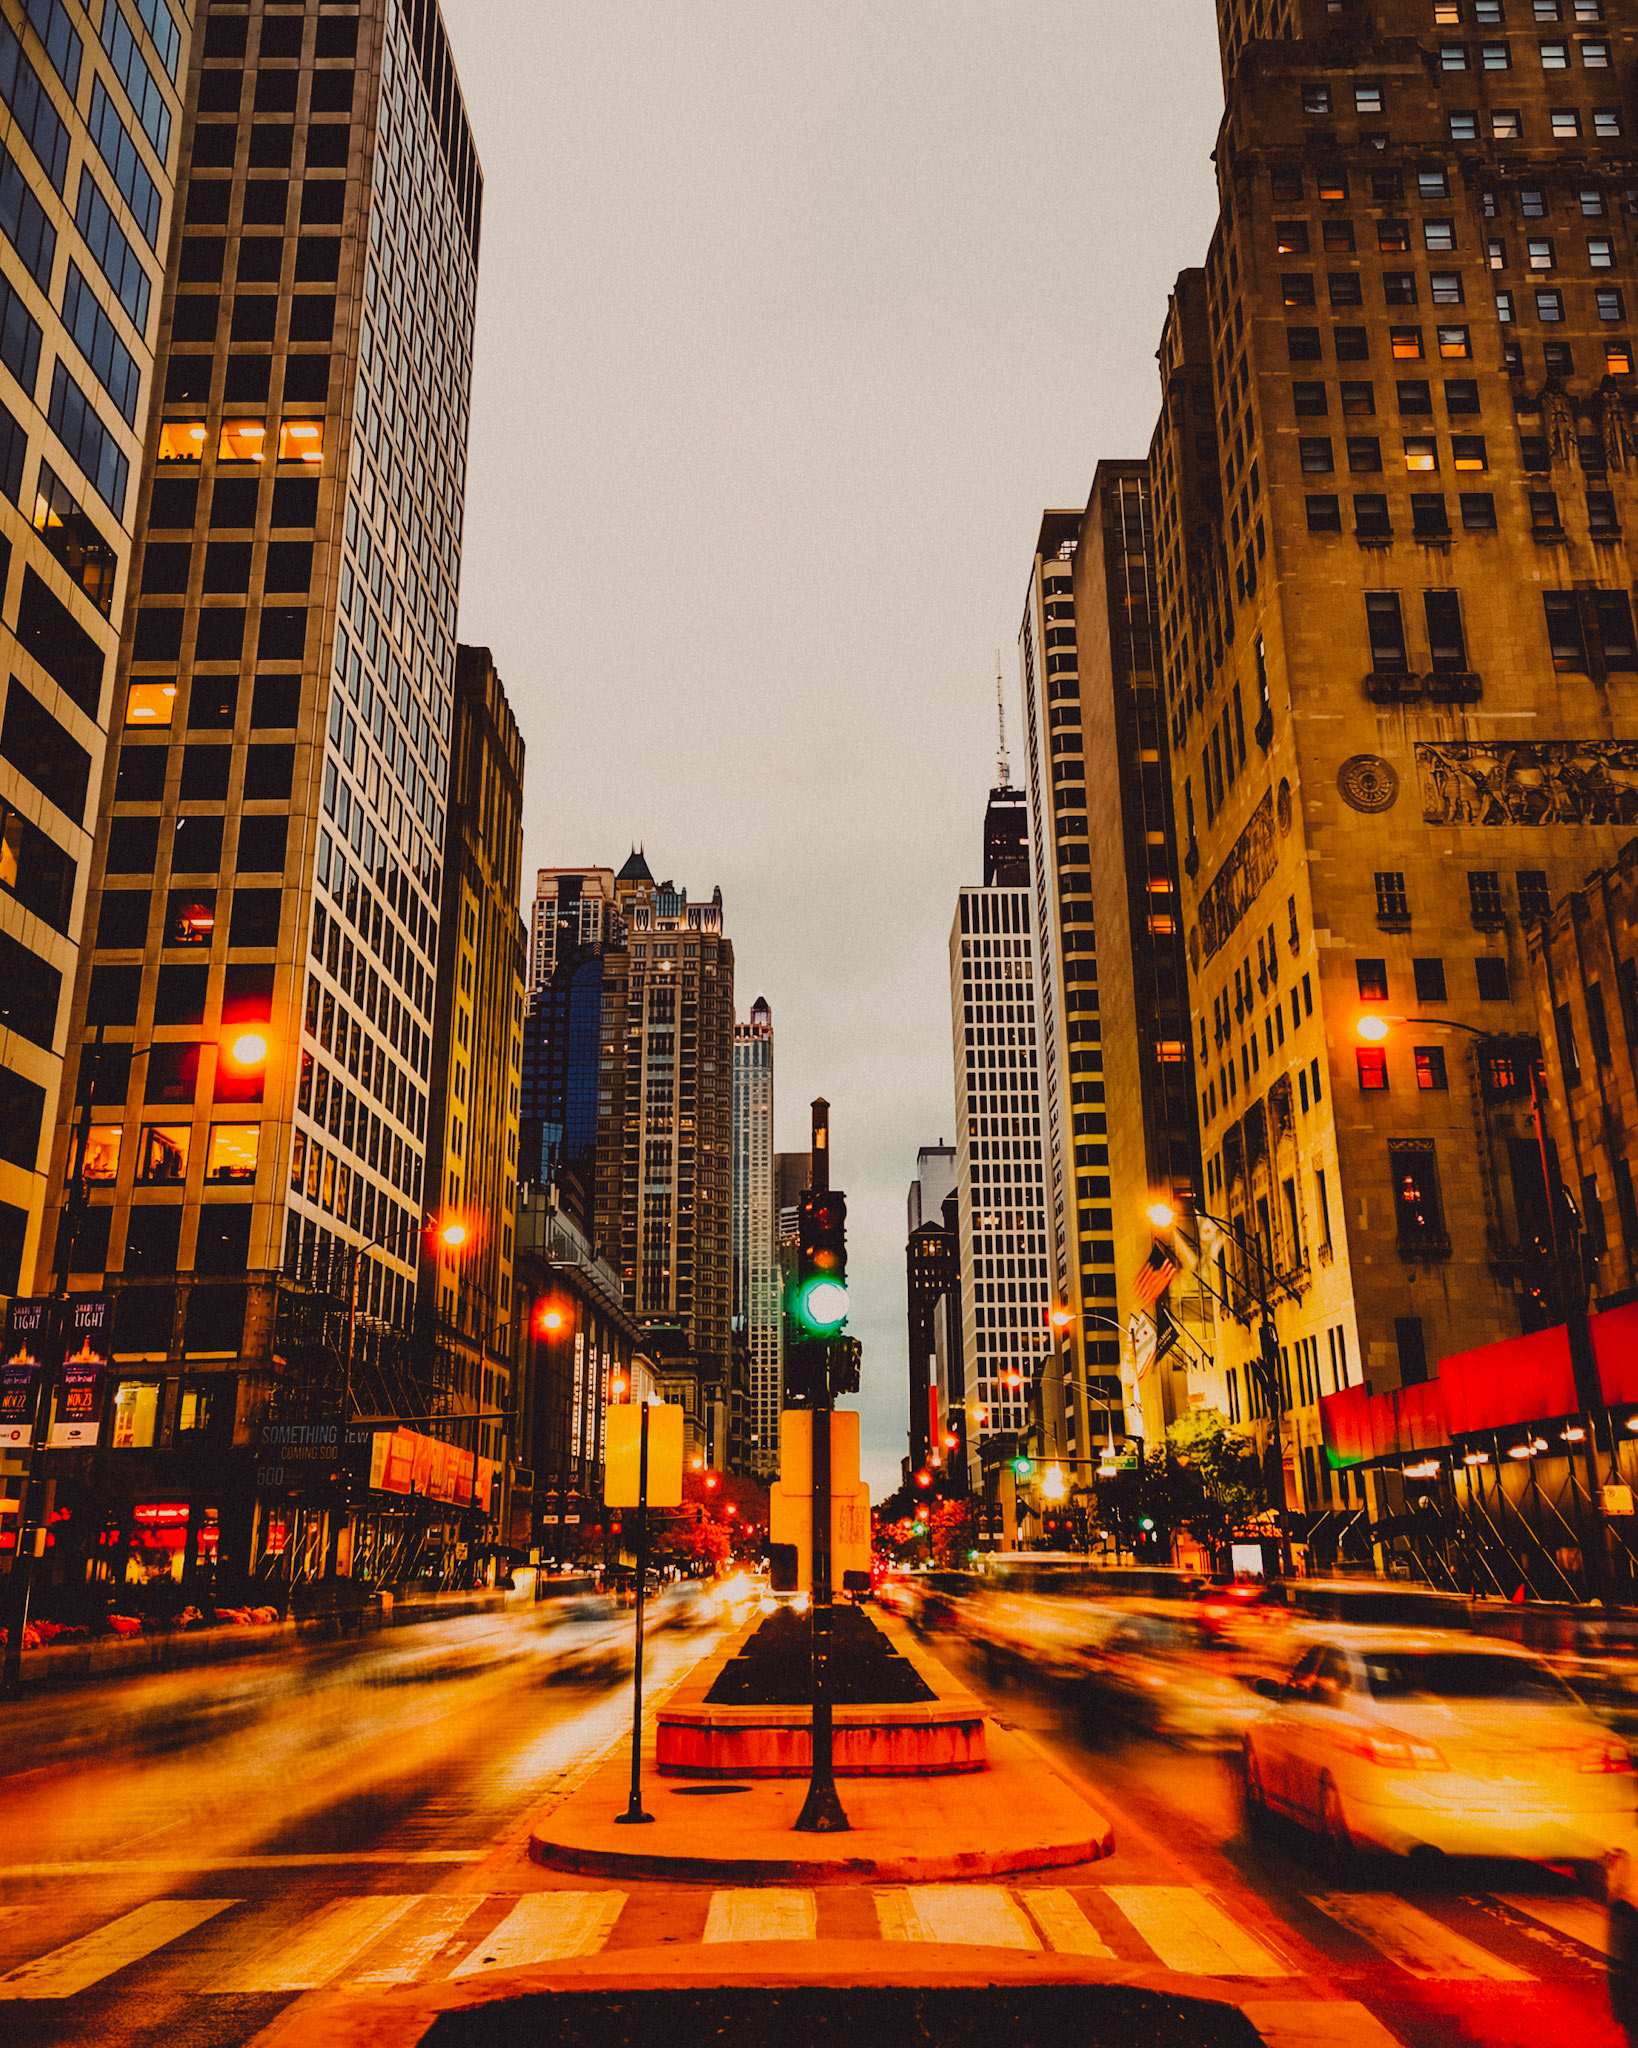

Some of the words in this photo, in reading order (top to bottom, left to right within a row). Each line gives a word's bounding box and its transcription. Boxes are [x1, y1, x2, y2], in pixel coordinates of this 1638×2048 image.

[75, 1304, 93, 1313] SHARE
[95, 1303, 105, 1312] THE
[13, 1314, 41, 1329] LIGHT
[75, 1312, 105, 1327] LIGHT
[262, 1425, 338, 1444] SOMETHING
[281, 1446, 319, 1460] COMING
[320, 1445, 339, 1460] SOO
[257, 1466, 284, 1486] 500
